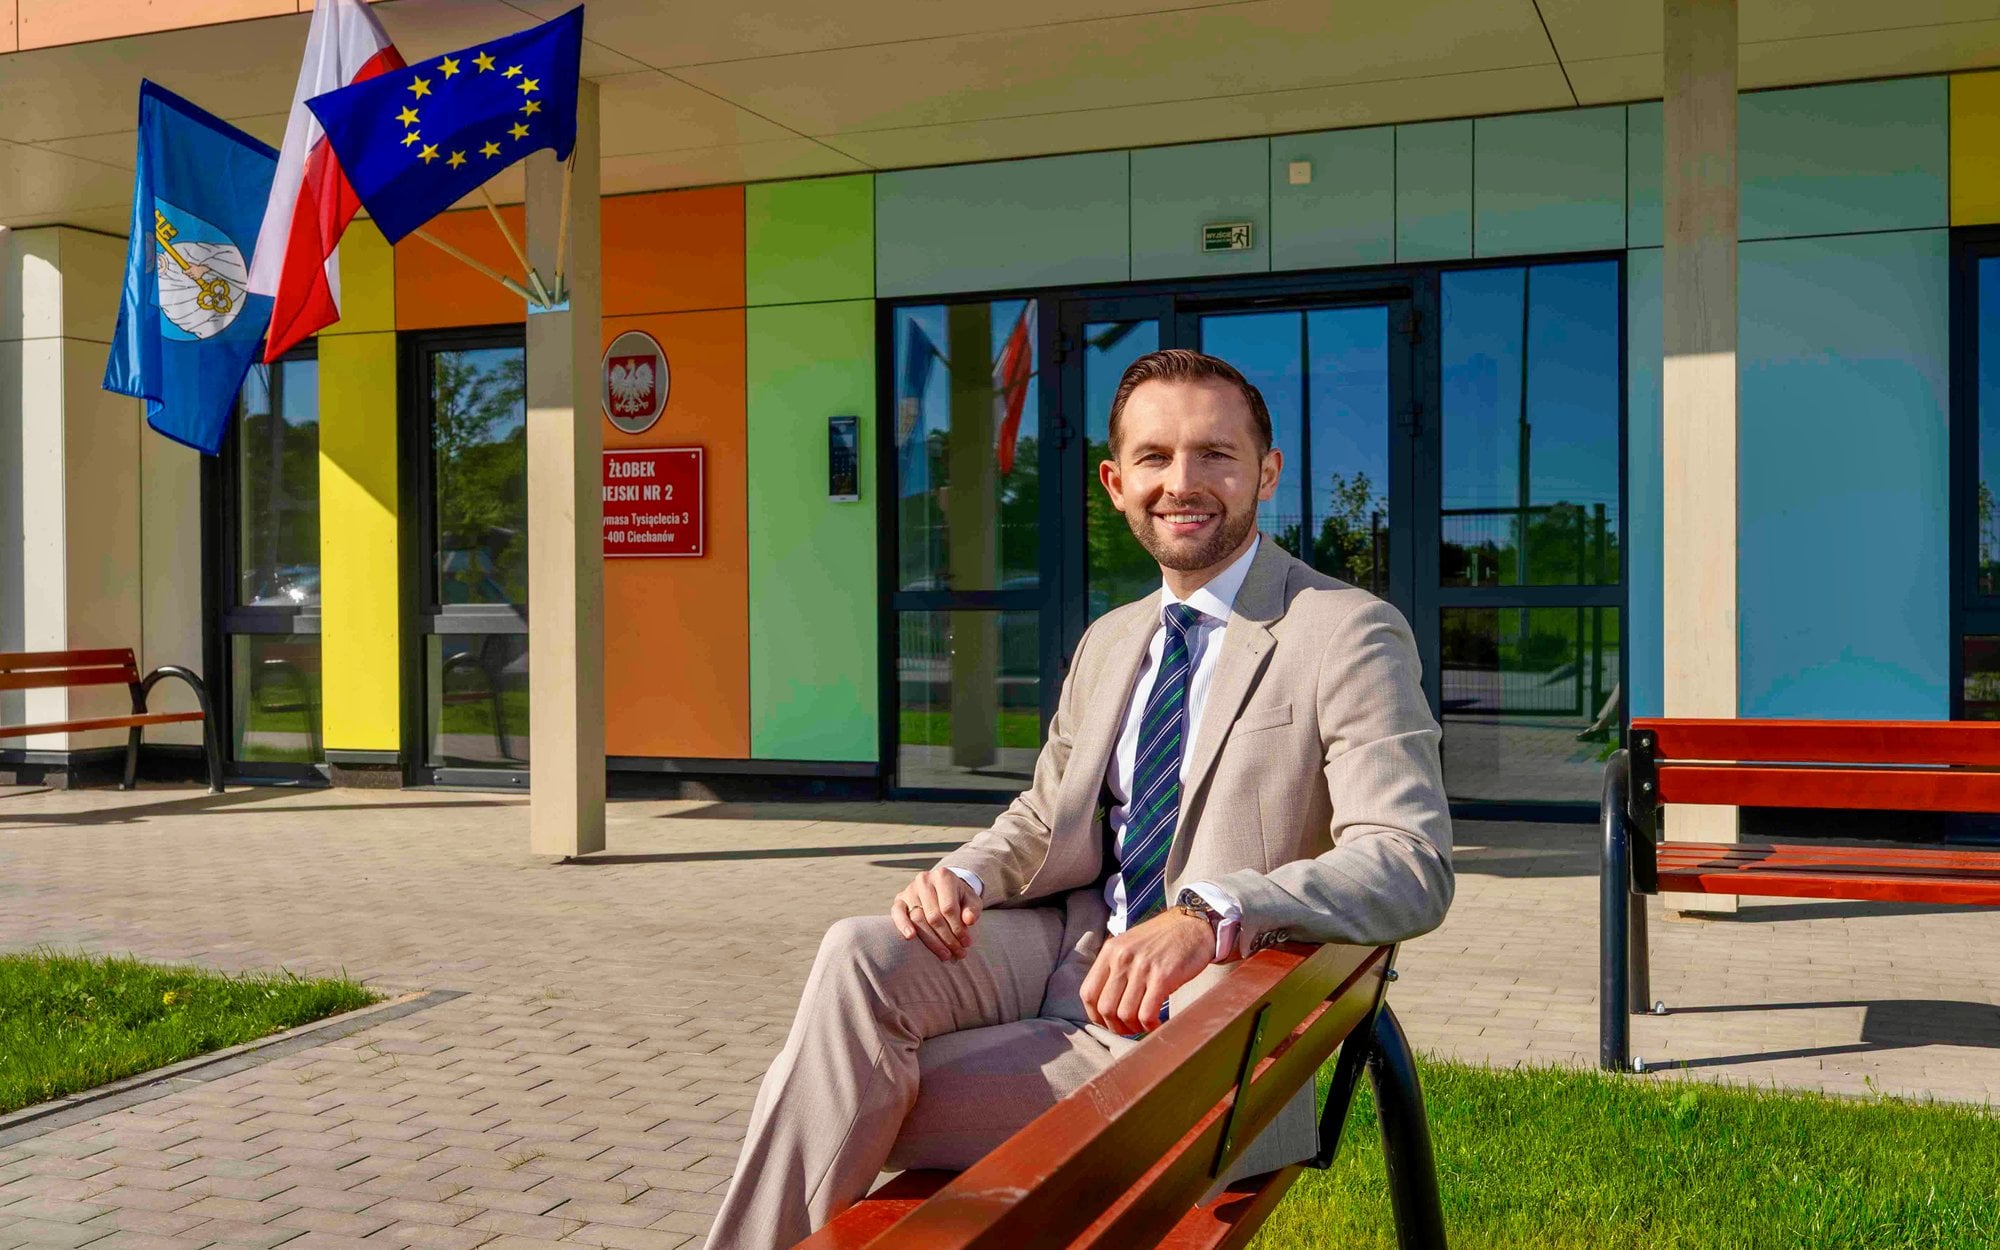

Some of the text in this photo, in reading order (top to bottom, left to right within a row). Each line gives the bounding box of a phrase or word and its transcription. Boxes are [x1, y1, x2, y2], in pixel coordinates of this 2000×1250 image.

[608, 458, 656, 478] ŻŁOBEK
[602, 484, 673, 501] IEJSKI NR 2
[603, 511, 689, 528] ymasa Tysiąclecia 3
[603, 529, 675, 543] -400 Ciechanów
